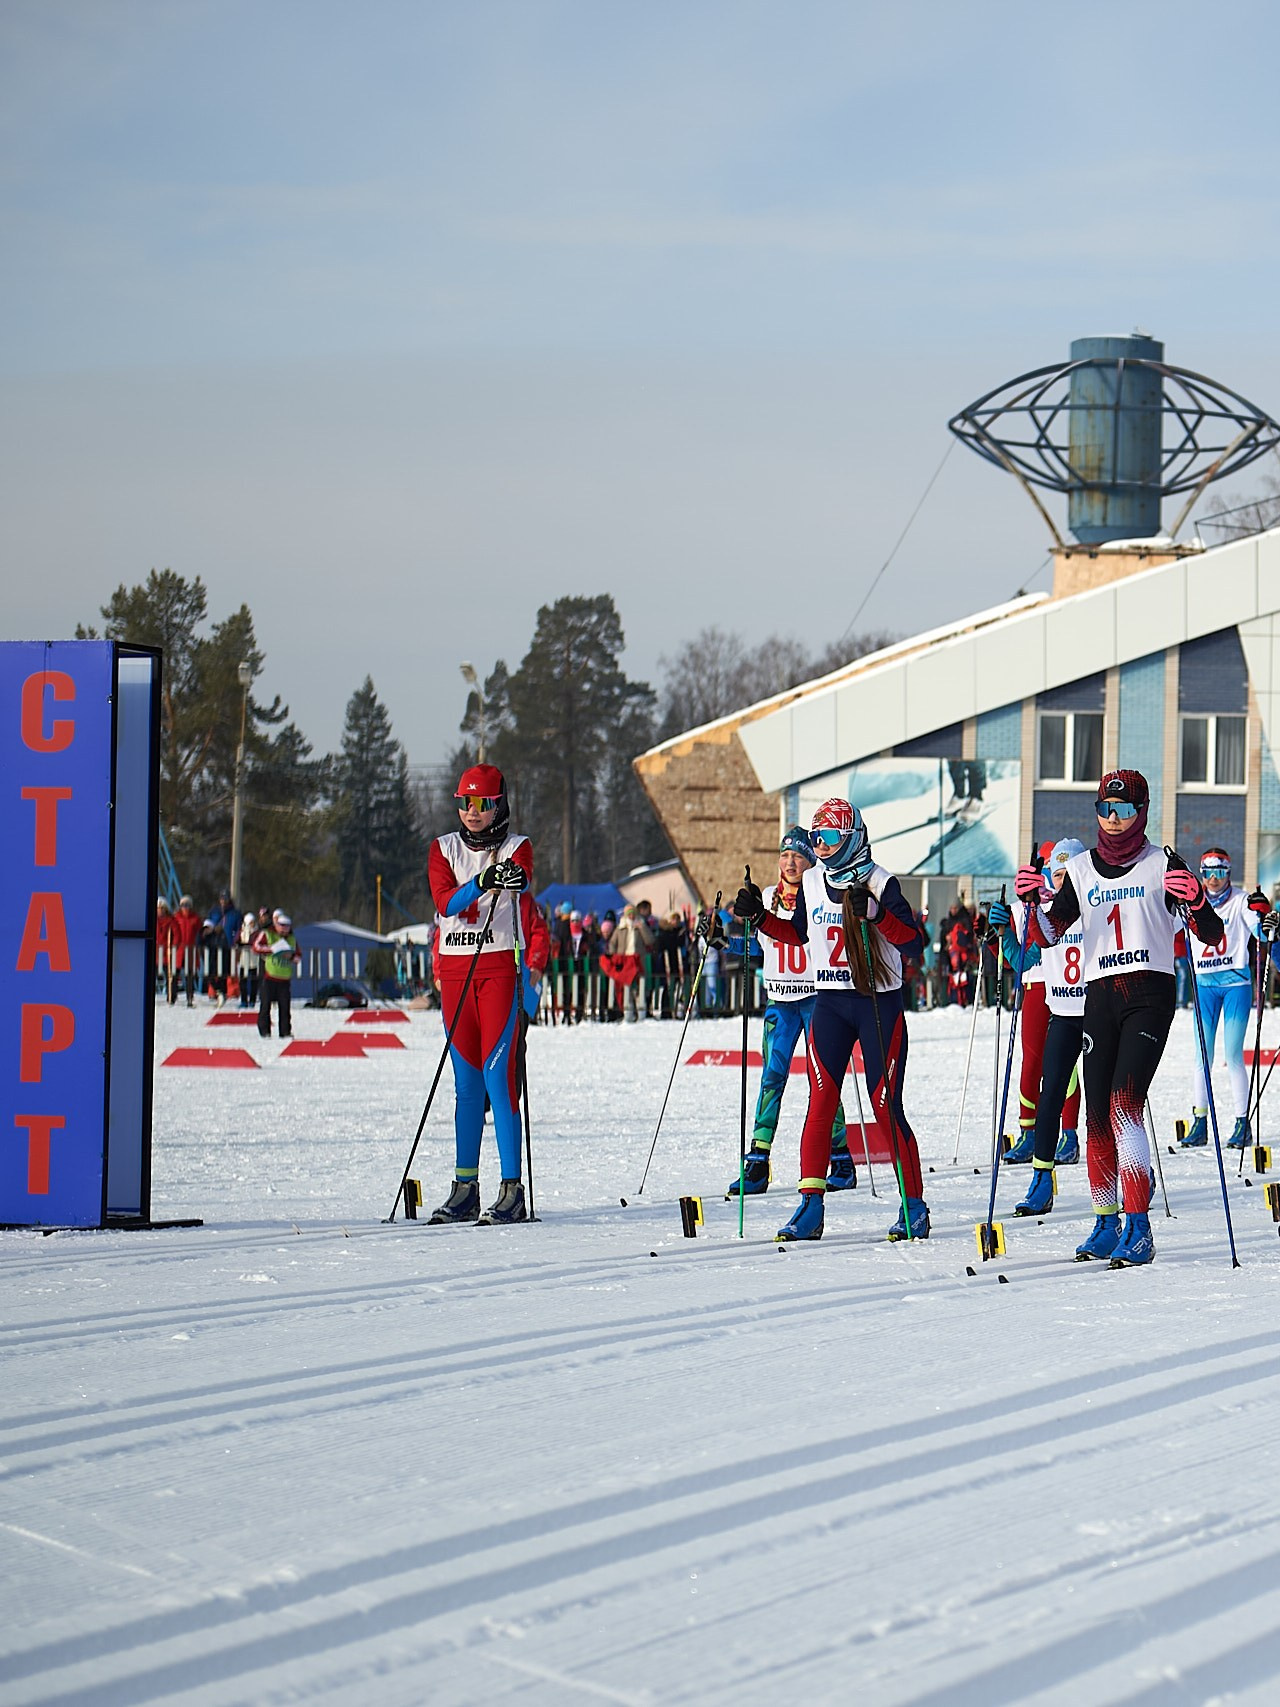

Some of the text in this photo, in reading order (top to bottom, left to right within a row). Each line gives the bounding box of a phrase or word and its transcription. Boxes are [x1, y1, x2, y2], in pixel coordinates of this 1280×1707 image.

[1102, 886, 1145, 902] ГАЗПРОМ
[823, 911, 844, 925] ГАЗП
[1106, 904, 1124, 951] 1
[14, 671, 76, 1195] СТАРТ
[773, 942, 807, 975] 10
[826, 926, 850, 968] 2
[1099, 949, 1150, 970] ИЖЕВСК
[816, 969, 853, 983] ИЖЕВ
[1064, 946, 1081, 985] 8
[1197, 956, 1233, 969] ИЖЕВСК
